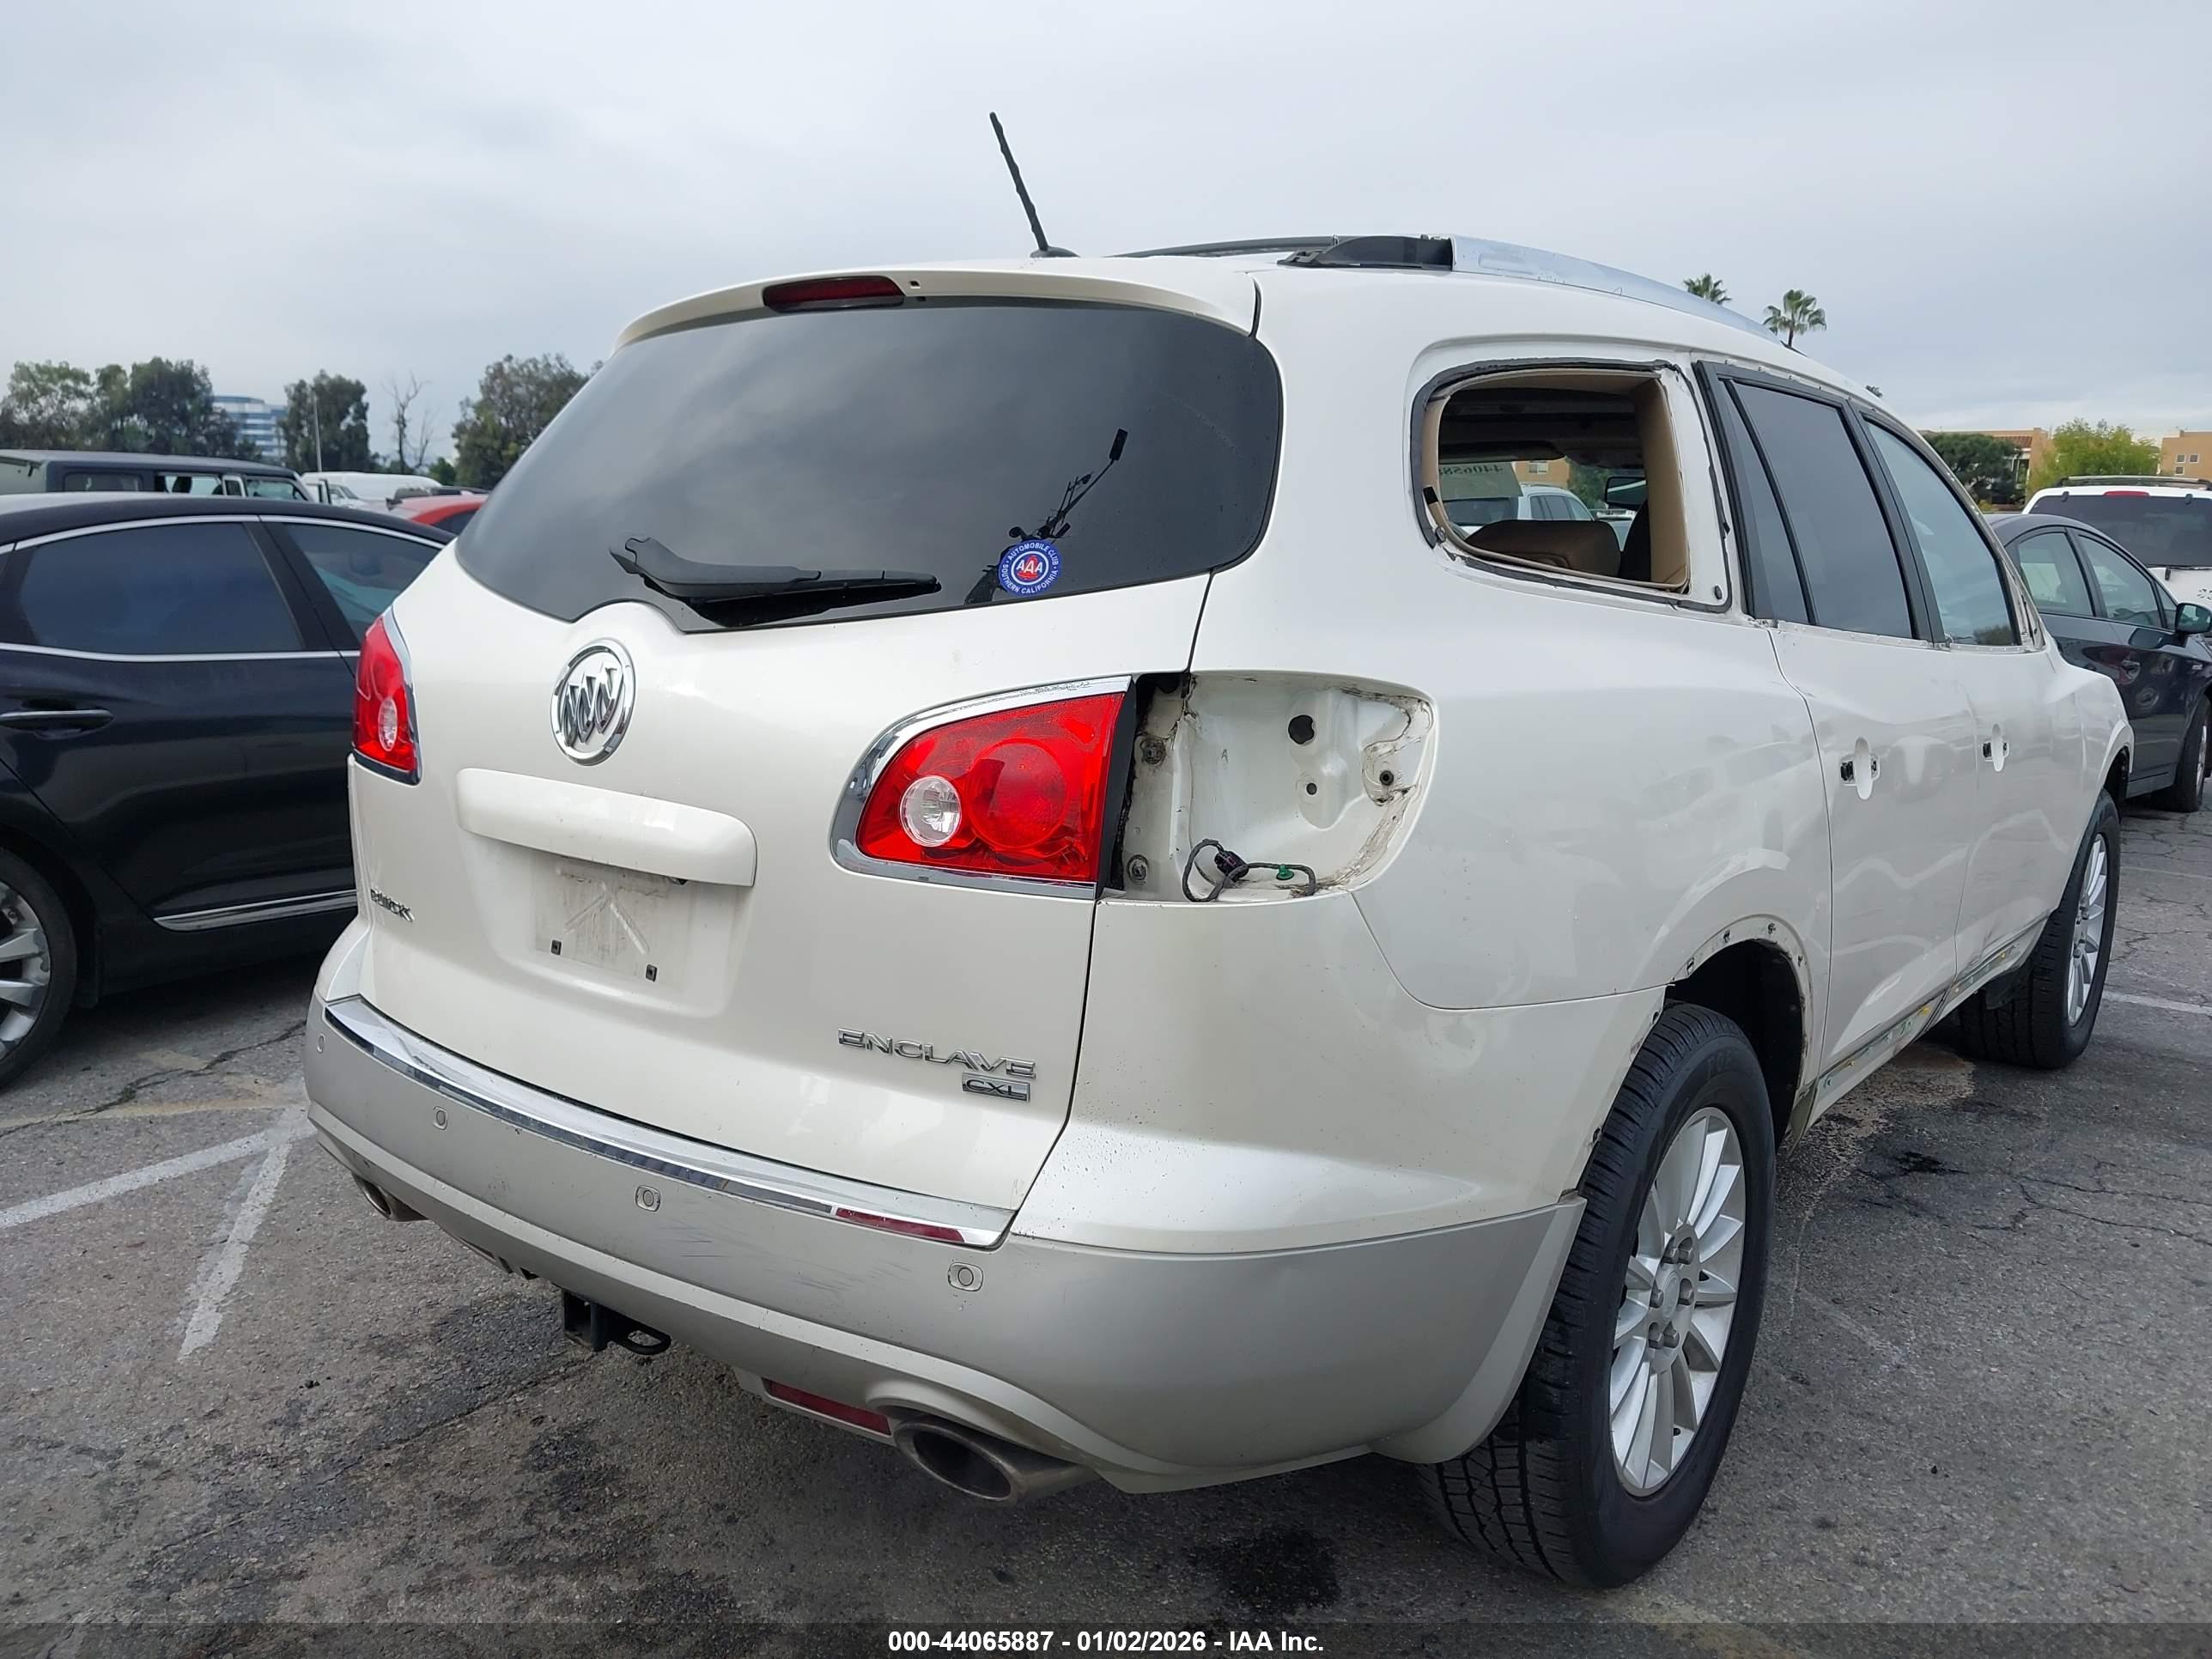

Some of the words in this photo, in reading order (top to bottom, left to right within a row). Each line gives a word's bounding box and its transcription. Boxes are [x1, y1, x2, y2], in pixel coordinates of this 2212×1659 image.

[1007, 542, 1049, 562] AUTOMOBILE
[1048, 550, 1059, 566] CLUB
[1016, 559, 1043, 574] AAA
[1001, 563, 1020, 592] SOUTHERN
[1021, 570, 1058, 594] CALIFORNIA
[370, 888, 414, 922] BUICK
[837, 1027, 1036, 1079] ENCLAVE
[965, 1079, 1027, 1100] CXL
